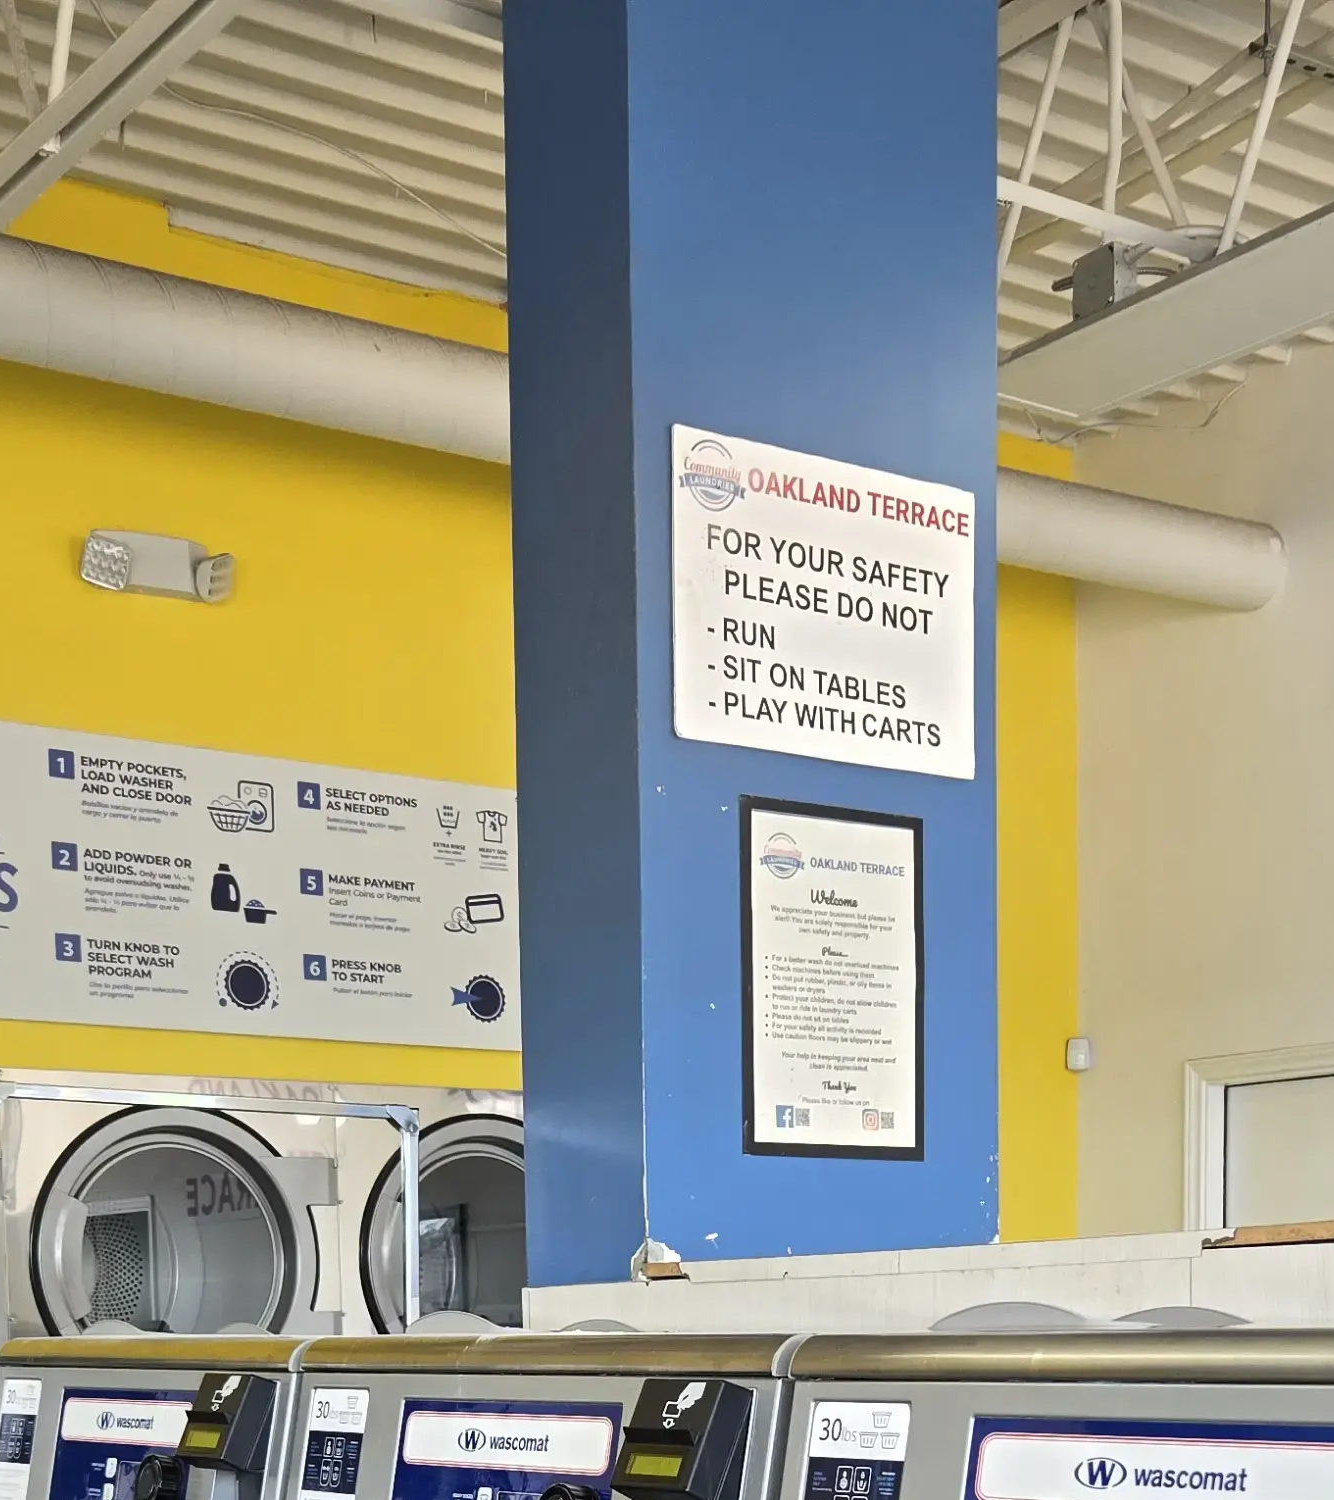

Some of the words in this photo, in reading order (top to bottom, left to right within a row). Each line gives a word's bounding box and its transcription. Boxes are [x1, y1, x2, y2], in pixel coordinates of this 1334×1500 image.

[748, 468, 861, 513] OAKLAND
[867, 491, 969, 537] TERRACE
[707, 524, 761, 560] FOR
[769, 537, 844, 577] YOUR
[852, 557, 949, 598] SAFETY
[725, 570, 828, 615] PLEASE
[838, 592, 873, 623] DO
[882, 602, 933, 635] NOT
[724, 618, 775, 650] RUN
[723, 655, 761, 683] SIT
[769, 662, 805, 691] ON
[814, 670, 907, 709] TABLES
[724, 691, 787, 724] PLAY
[795, 702, 856, 735] WITH
[863, 713, 941, 748] CARTS
[57, 757, 65, 773] 1
[81, 756, 124, 771] EMPTY
[127, 762, 187, 781] POCKETS,
[81, 769, 115, 782] LOAD
[119, 775, 173, 790] WASHER
[81, 783, 109, 795] AND
[113, 787, 152, 801] CLOSE
[156, 792, 192, 806] DOOR
[304, 789, 315, 804] 4
[326, 788, 366, 802] SELECT
[370, 793, 417, 808] OPTIONS
[326, 801, 342, 811] AS
[344, 802, 389, 817] NEEDED
[59, 849, 70, 866] 2
[83, 848, 111, 860] ADD
[115, 852, 170, 867] POWDER
[174, 857, 192, 869] OR
[84, 861, 137, 876] LIQUIDS.
[139, 870, 156, 879] Only
[810, 857, 858, 872] OAKLAND
[860, 863, 905, 877] TERRACE
[94, 875, 114, 884] avoid
[307, 876, 316, 890] 5
[328, 874, 361, 886] MAKE
[364, 878, 415, 892] PAYMENT
[329, 887, 351, 896] Insert
[353, 890, 375, 898] Coins
[387, 892, 422, 903] Payment
[329, 898, 348, 907] Card
[811, 889, 858, 908] Welcome
[63, 941, 74, 957] 3
[87, 938, 121, 950] TURN
[125, 942, 160, 954] KNOB
[163, 945, 180, 955] TO
[88, 952, 133, 965] SELECT
[136, 955, 174, 968] WASH
[310, 962, 321, 976] 6
[332, 959, 367, 971] PRESS
[370, 962, 402, 974] KNOB
[89, 965, 152, 979] PROGRAM
[332, 972, 348, 981] TO
[350, 973, 384, 984] START
[822, 1081, 842, 1091] Thank
[843, 1082, 857, 1093] You
[116, 1411, 154, 1431] wascomat
[489, 1432, 549, 1452] wascomat
[1133, 1466, 1249, 1493] wascomat
